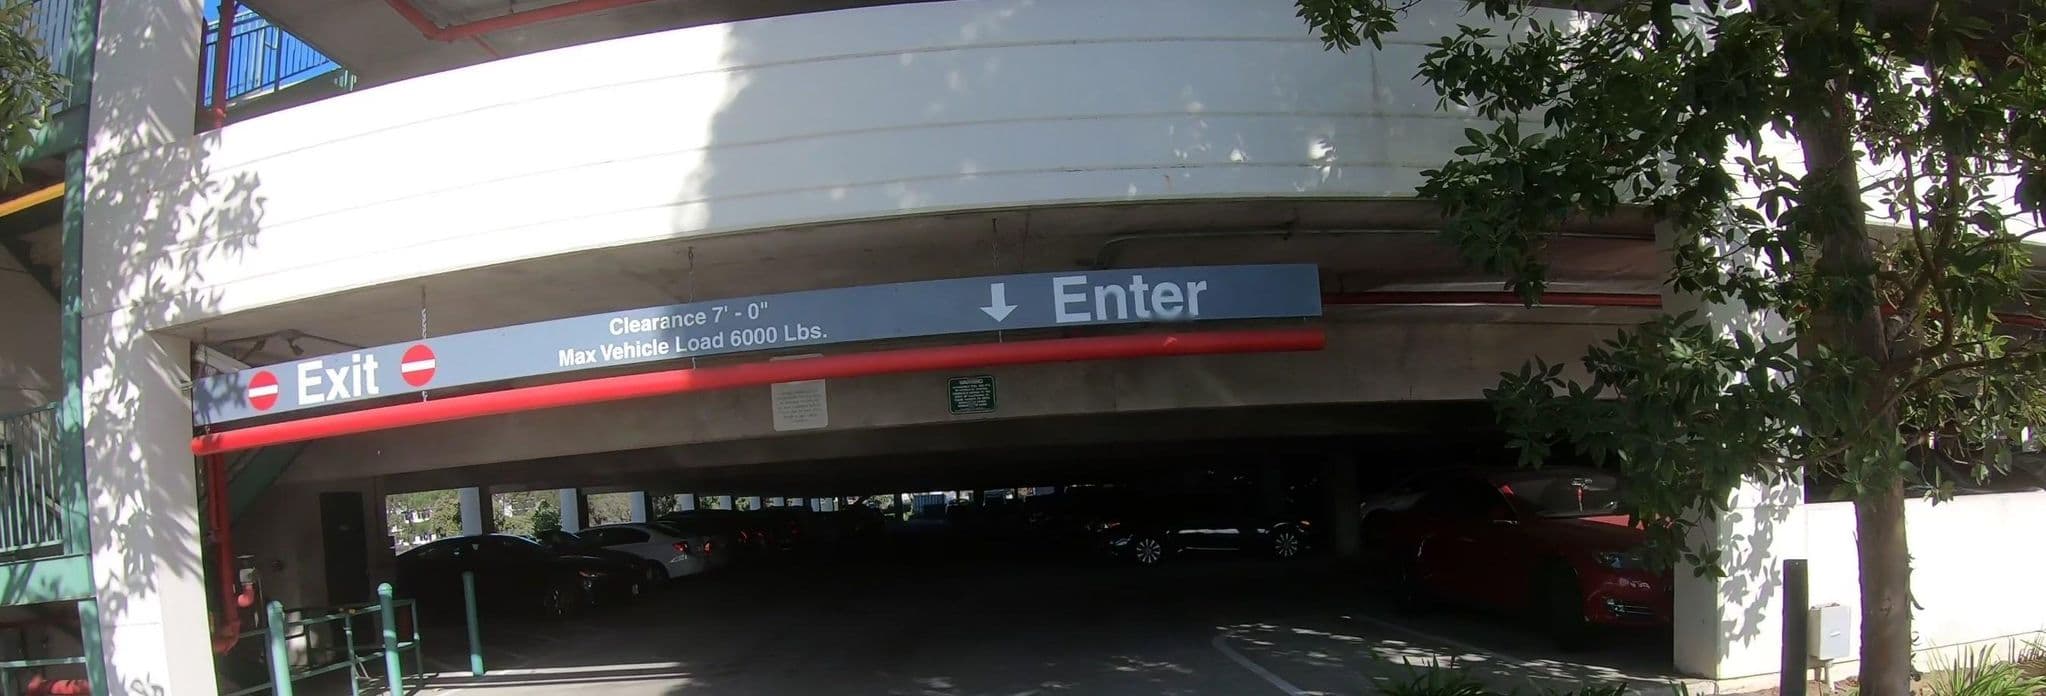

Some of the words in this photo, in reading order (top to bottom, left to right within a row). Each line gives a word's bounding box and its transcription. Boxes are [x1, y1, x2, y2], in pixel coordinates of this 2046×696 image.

[609, 310, 706, 336] Clearance
[711, 305, 728, 323] 7'
[747, 301, 768, 320] 0"
[1053, 275, 1207, 323] Enter
[558, 348, 597, 367] Max
[600, 336, 669, 361] Vehicle
[676, 331, 723, 353] Load
[730, 326, 777, 347] 6000
[784, 324, 827, 342] Lbs.
[297, 353, 379, 405] Exit
